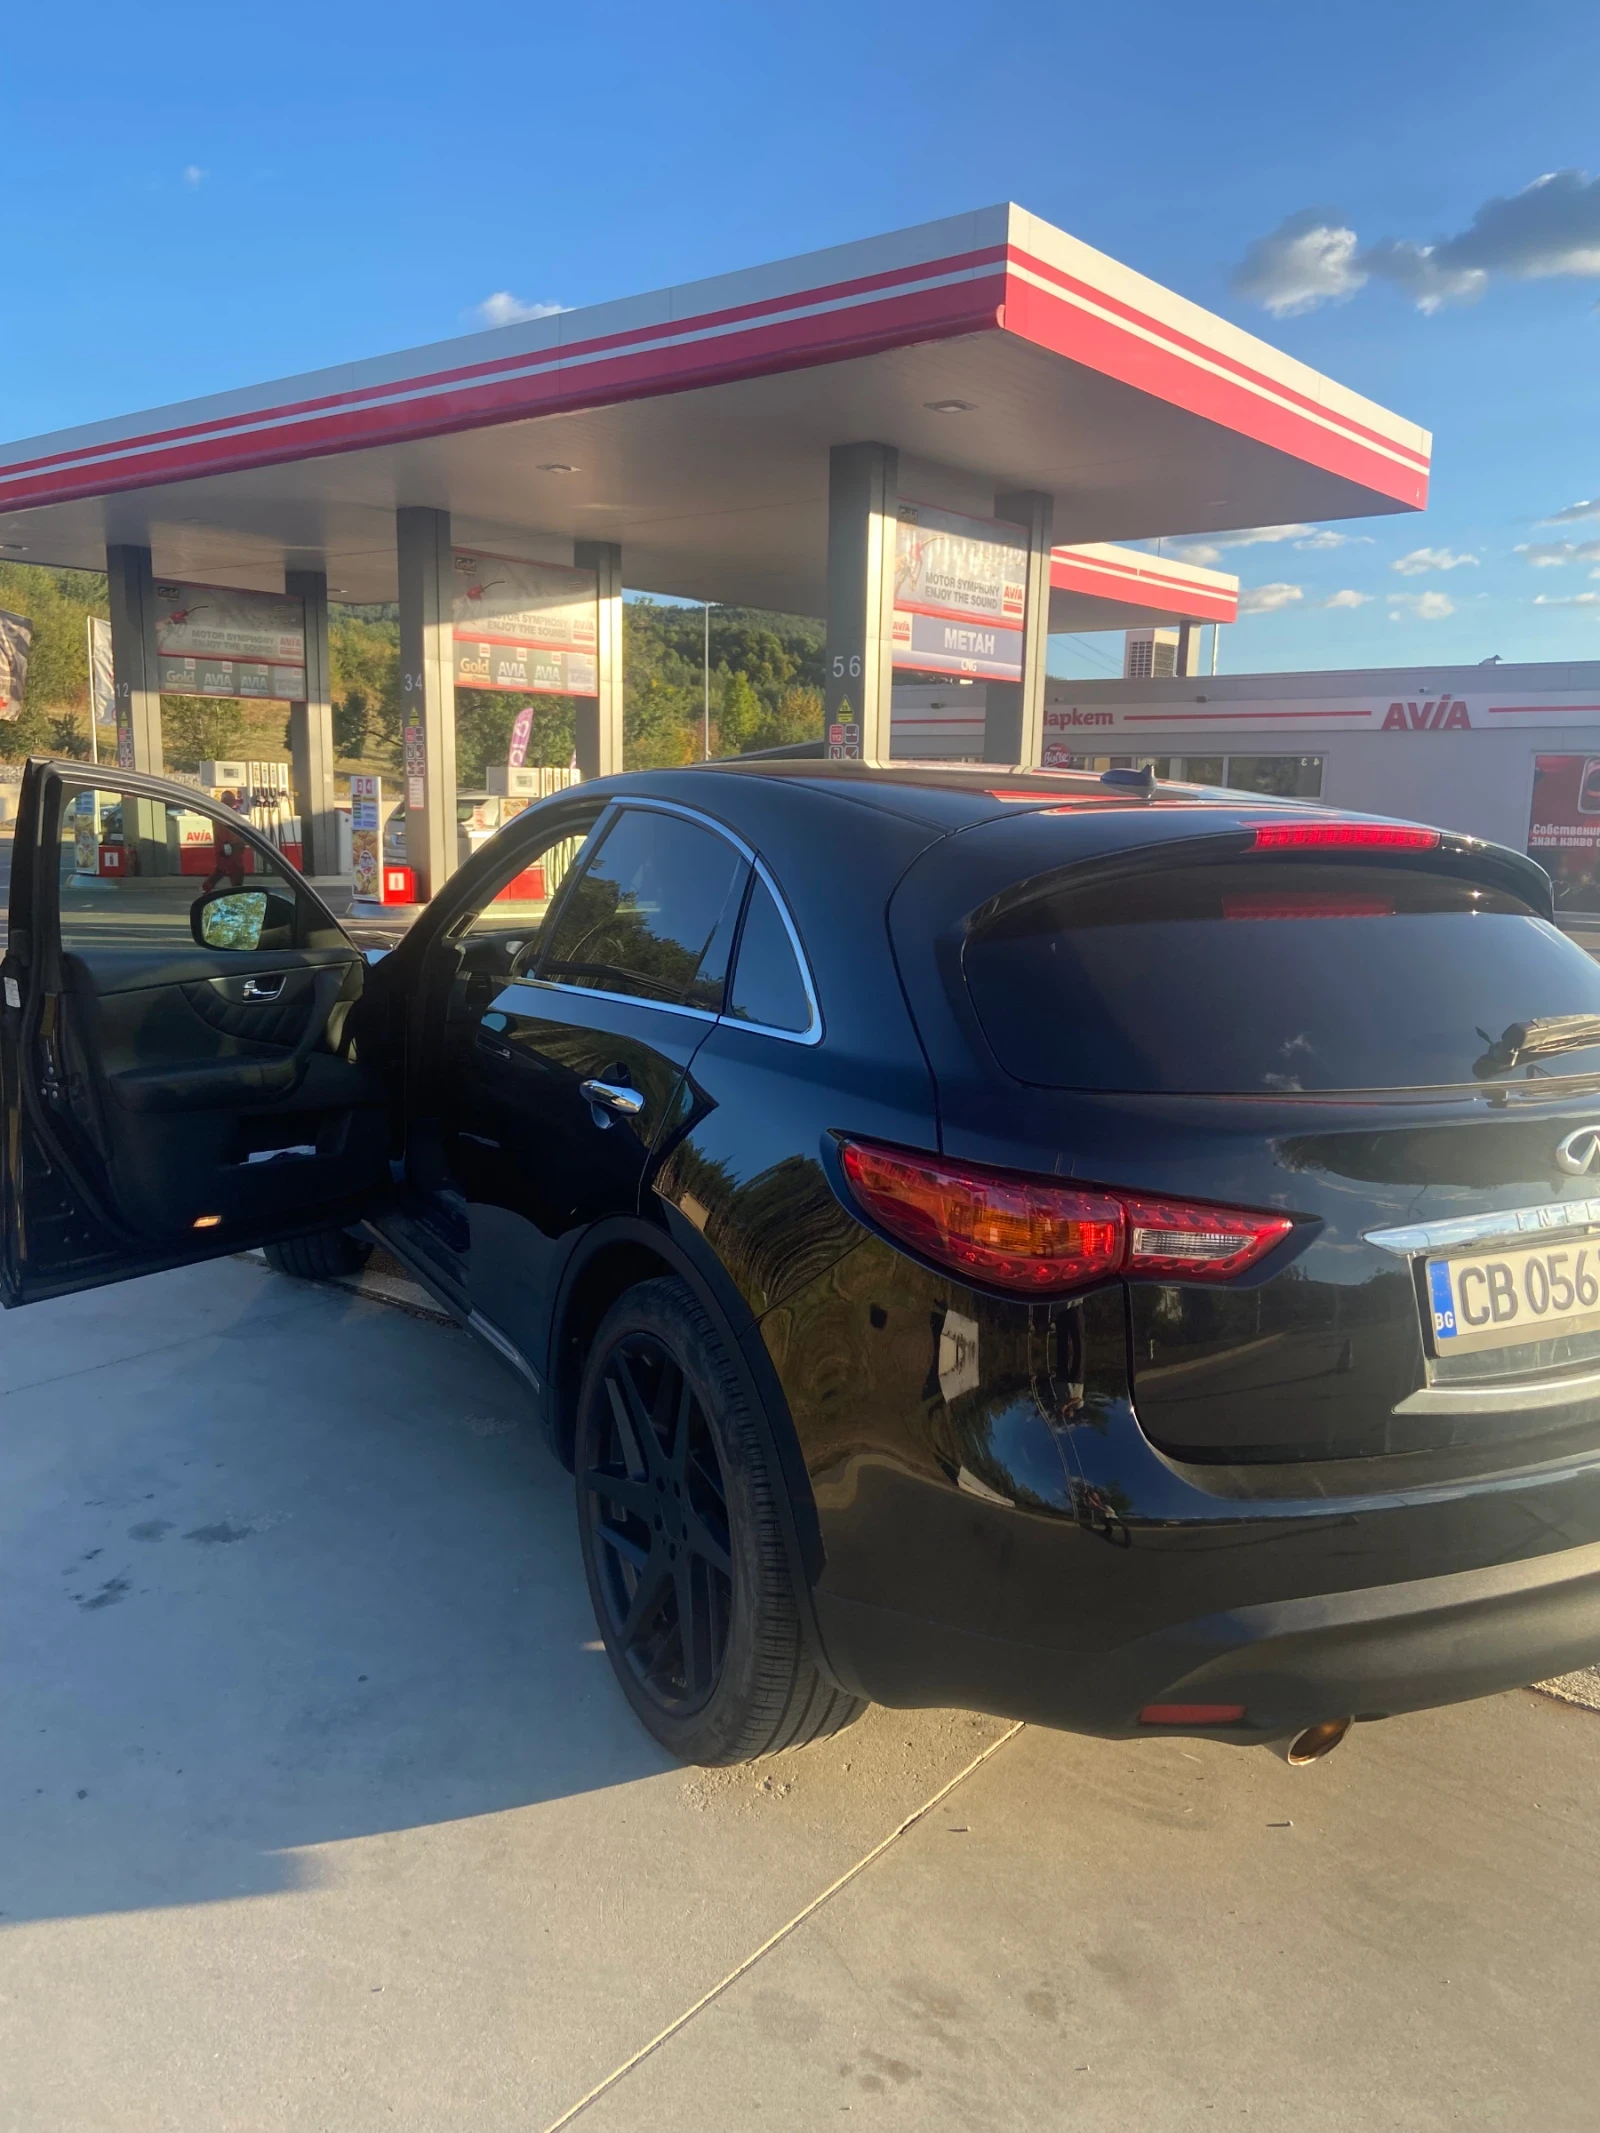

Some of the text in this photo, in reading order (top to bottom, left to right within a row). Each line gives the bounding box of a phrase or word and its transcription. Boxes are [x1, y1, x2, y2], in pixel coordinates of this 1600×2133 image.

[925, 572, 1000, 597] MOTOR SYMPHONY
[925, 585, 998, 610] ENJOY THE SOUND
[522, 614, 569, 628] SYMPHONY
[191, 630, 275, 644] MOTOR SYMPHONY
[487, 621, 567, 638] ENJOY THE SOUND
[191, 639, 221, 649] ENJOY
[223, 641, 241, 651] THE
[460, 657, 490, 674] Gold
[498, 661, 527, 678] AVIA
[535, 665, 561, 681] AVIA
[960, 659, 977, 672] CNG
[166, 669, 195, 682] Gold
[204, 672, 233, 687] AVIA
[241, 675, 269, 689] AVIA
[1533, 823, 1600, 836] Собствени
[1531, 837, 1557, 846] знае
[1559, 837, 1593, 847] какво
[1458, 1263, 1518, 1326] CB
[1434, 1311, 1454, 1331] BG
